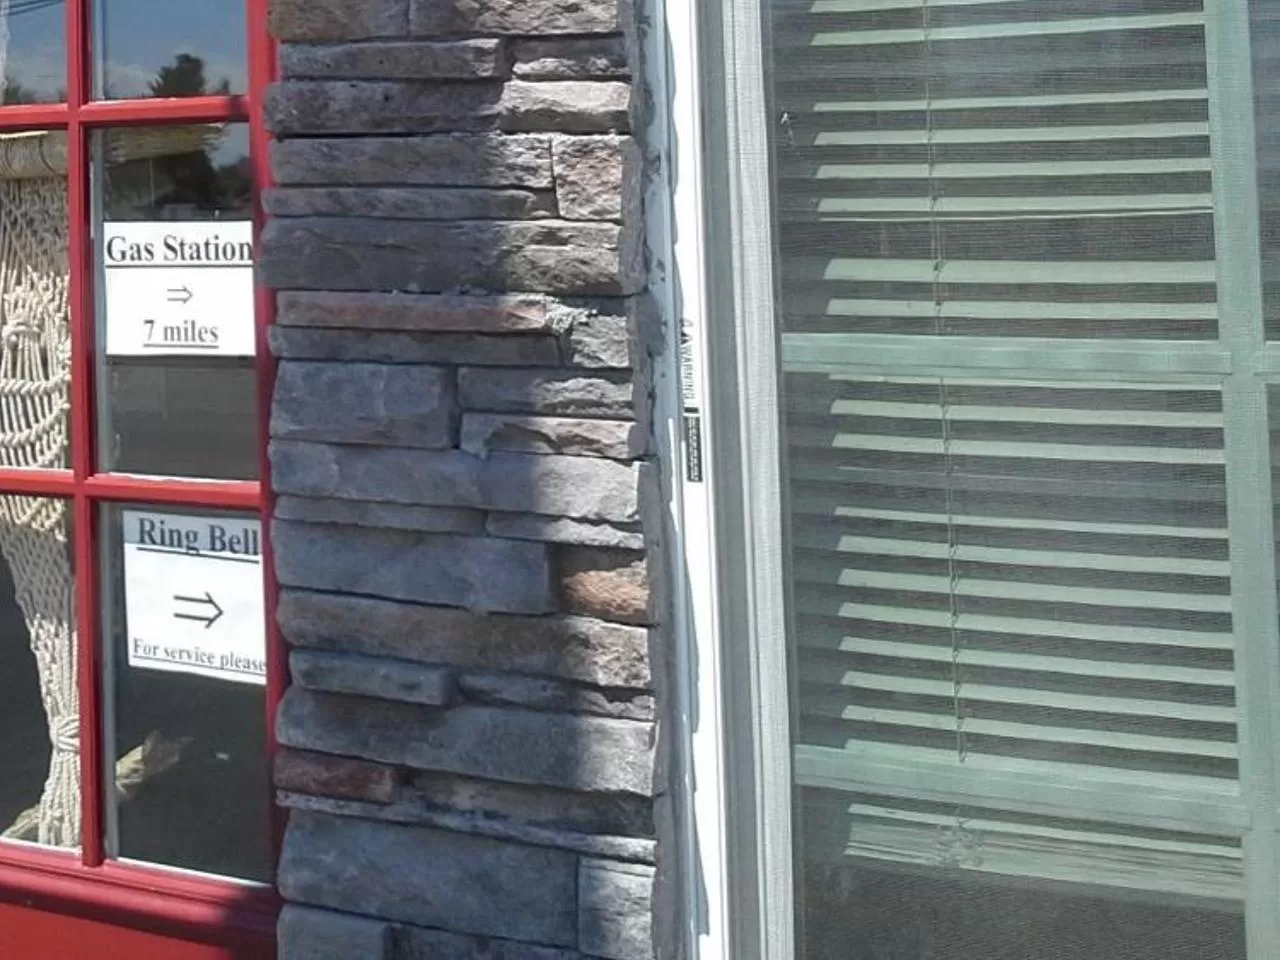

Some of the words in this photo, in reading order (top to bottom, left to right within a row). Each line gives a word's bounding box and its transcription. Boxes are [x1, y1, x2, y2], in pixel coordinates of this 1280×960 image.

[106, 235, 155, 262] Gas
[162, 234, 253, 262] Station
[143, 319, 155, 341] 7
[163, 320, 219, 342] miles
[138, 517, 200, 555] Ring
[208, 524, 259, 556] Bell
[133, 637, 159, 658] For
[163, 645, 215, 665] service
[220, 650, 266, 672] please
